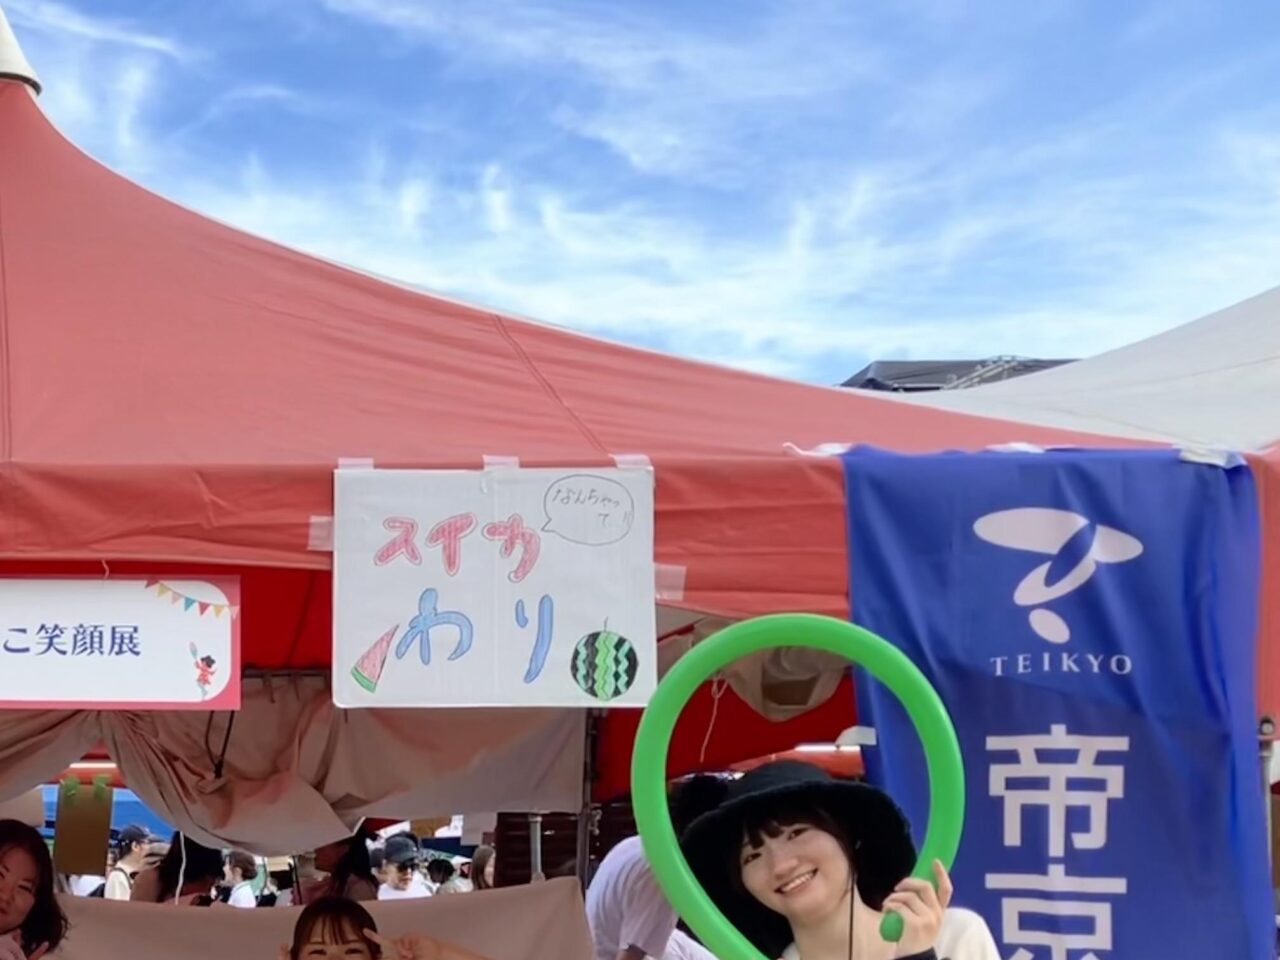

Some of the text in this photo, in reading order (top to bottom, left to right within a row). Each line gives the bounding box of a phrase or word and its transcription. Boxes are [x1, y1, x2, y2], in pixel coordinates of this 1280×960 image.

[374, 511, 542, 583] スイカ
[395, 587, 555, 684] わり
[990, 652, 1133, 676] TEIKYO
